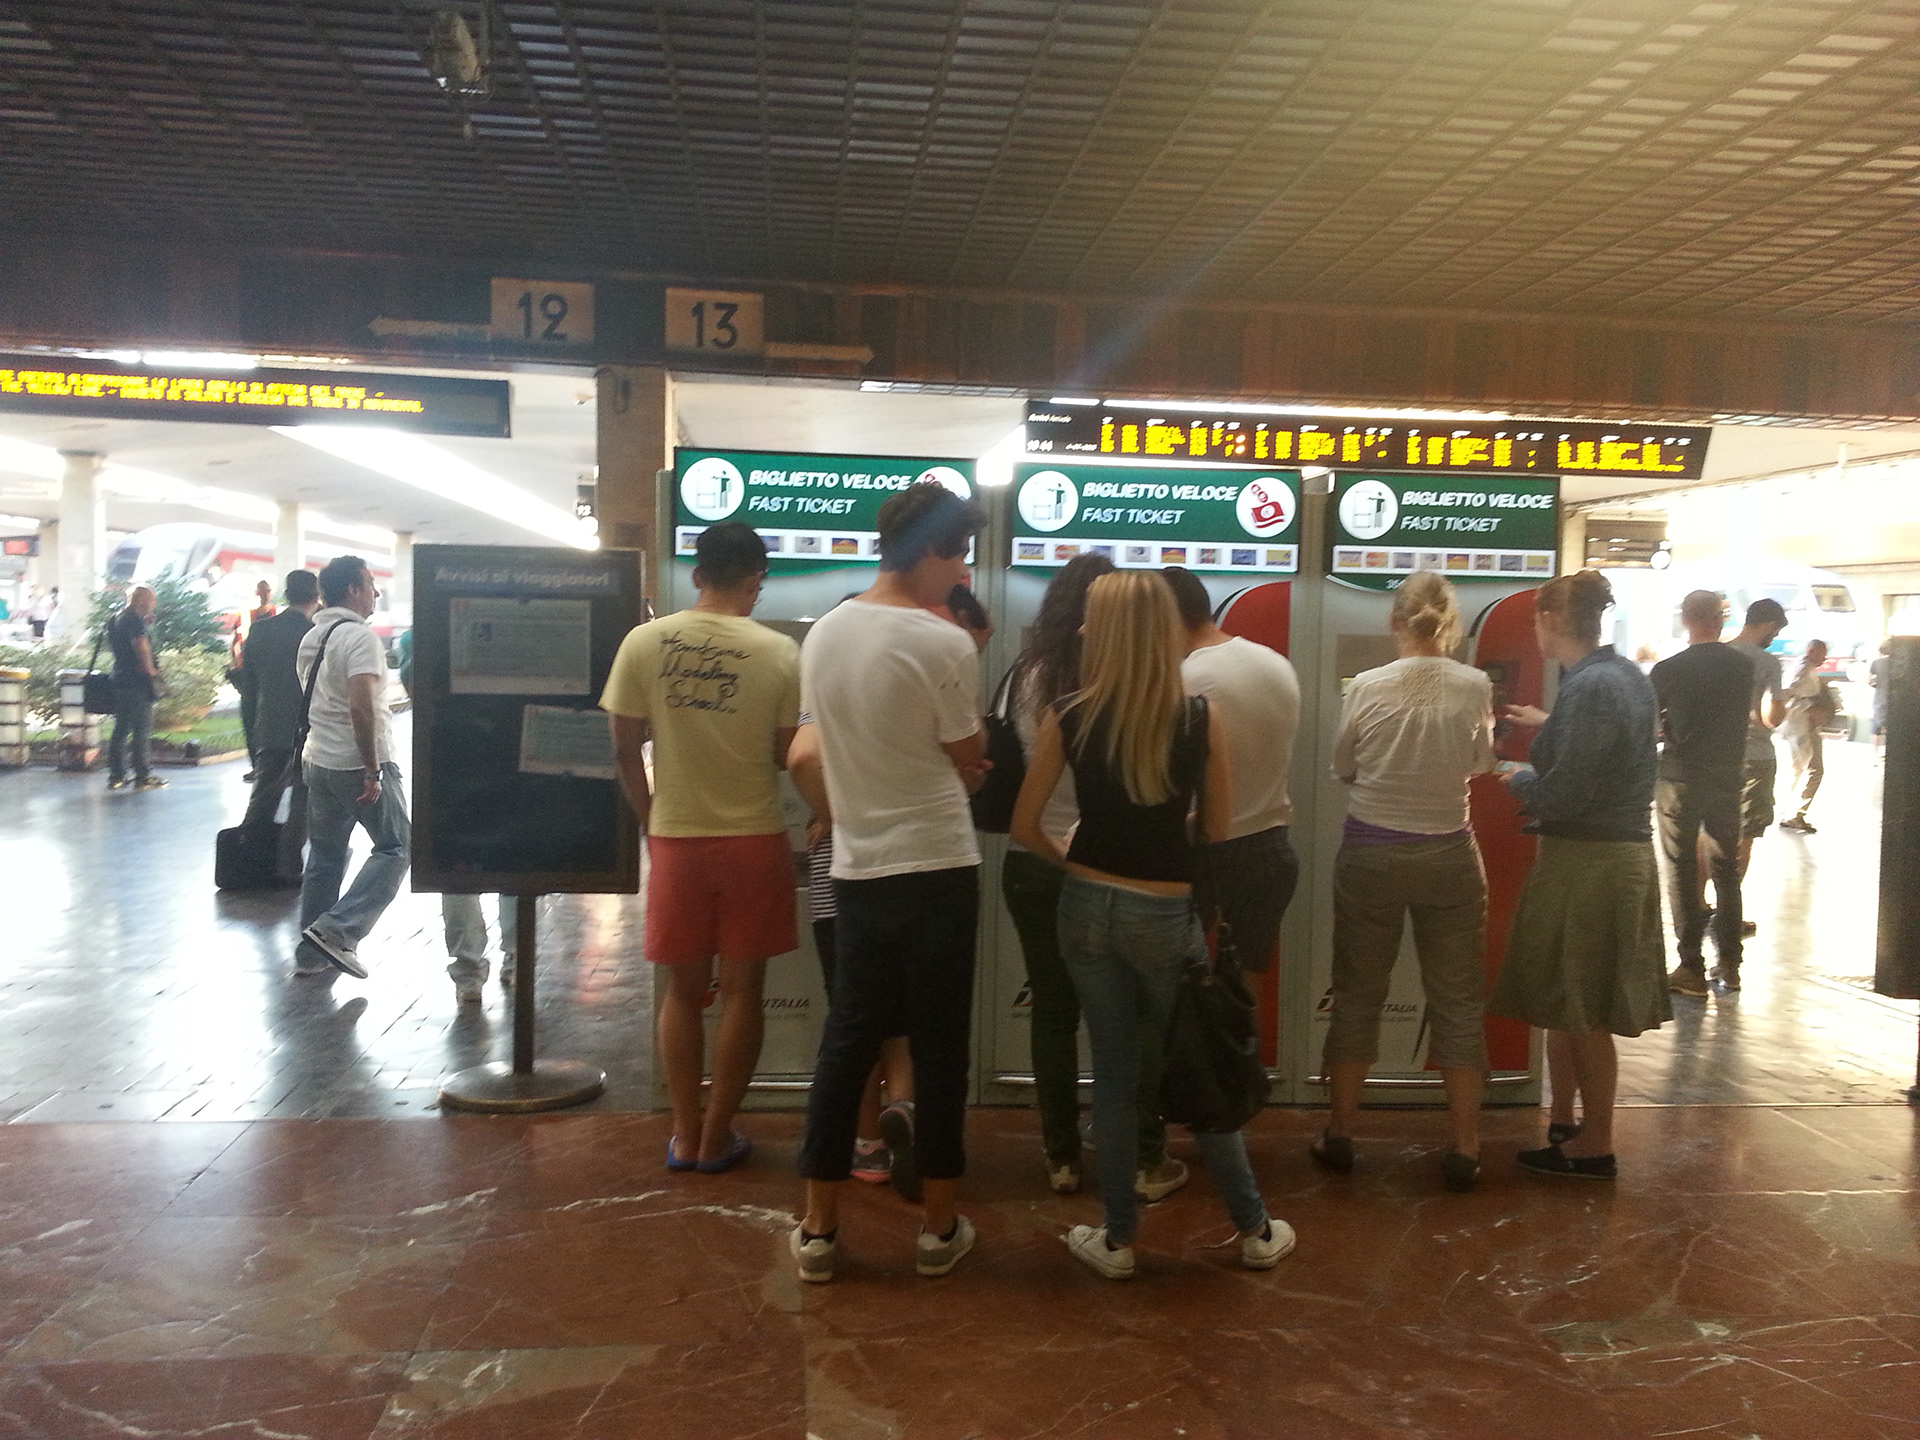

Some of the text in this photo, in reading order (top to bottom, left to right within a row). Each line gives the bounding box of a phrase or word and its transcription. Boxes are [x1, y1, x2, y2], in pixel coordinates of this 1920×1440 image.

[516, 292, 568, 341] 12
[691, 301, 739, 350] 13
[748, 470, 911, 491] BIGLIETTO VELOCE
[1082, 482, 1239, 501] BIGLIETTO VELOCE
[1401, 491, 1554, 509] BIGLIETTO VELOCE
[748, 496, 857, 515] FAST TICKET
[1082, 508, 1186, 525] FAST TICKET
[1400, 515, 1502, 532] FAST TICKET
